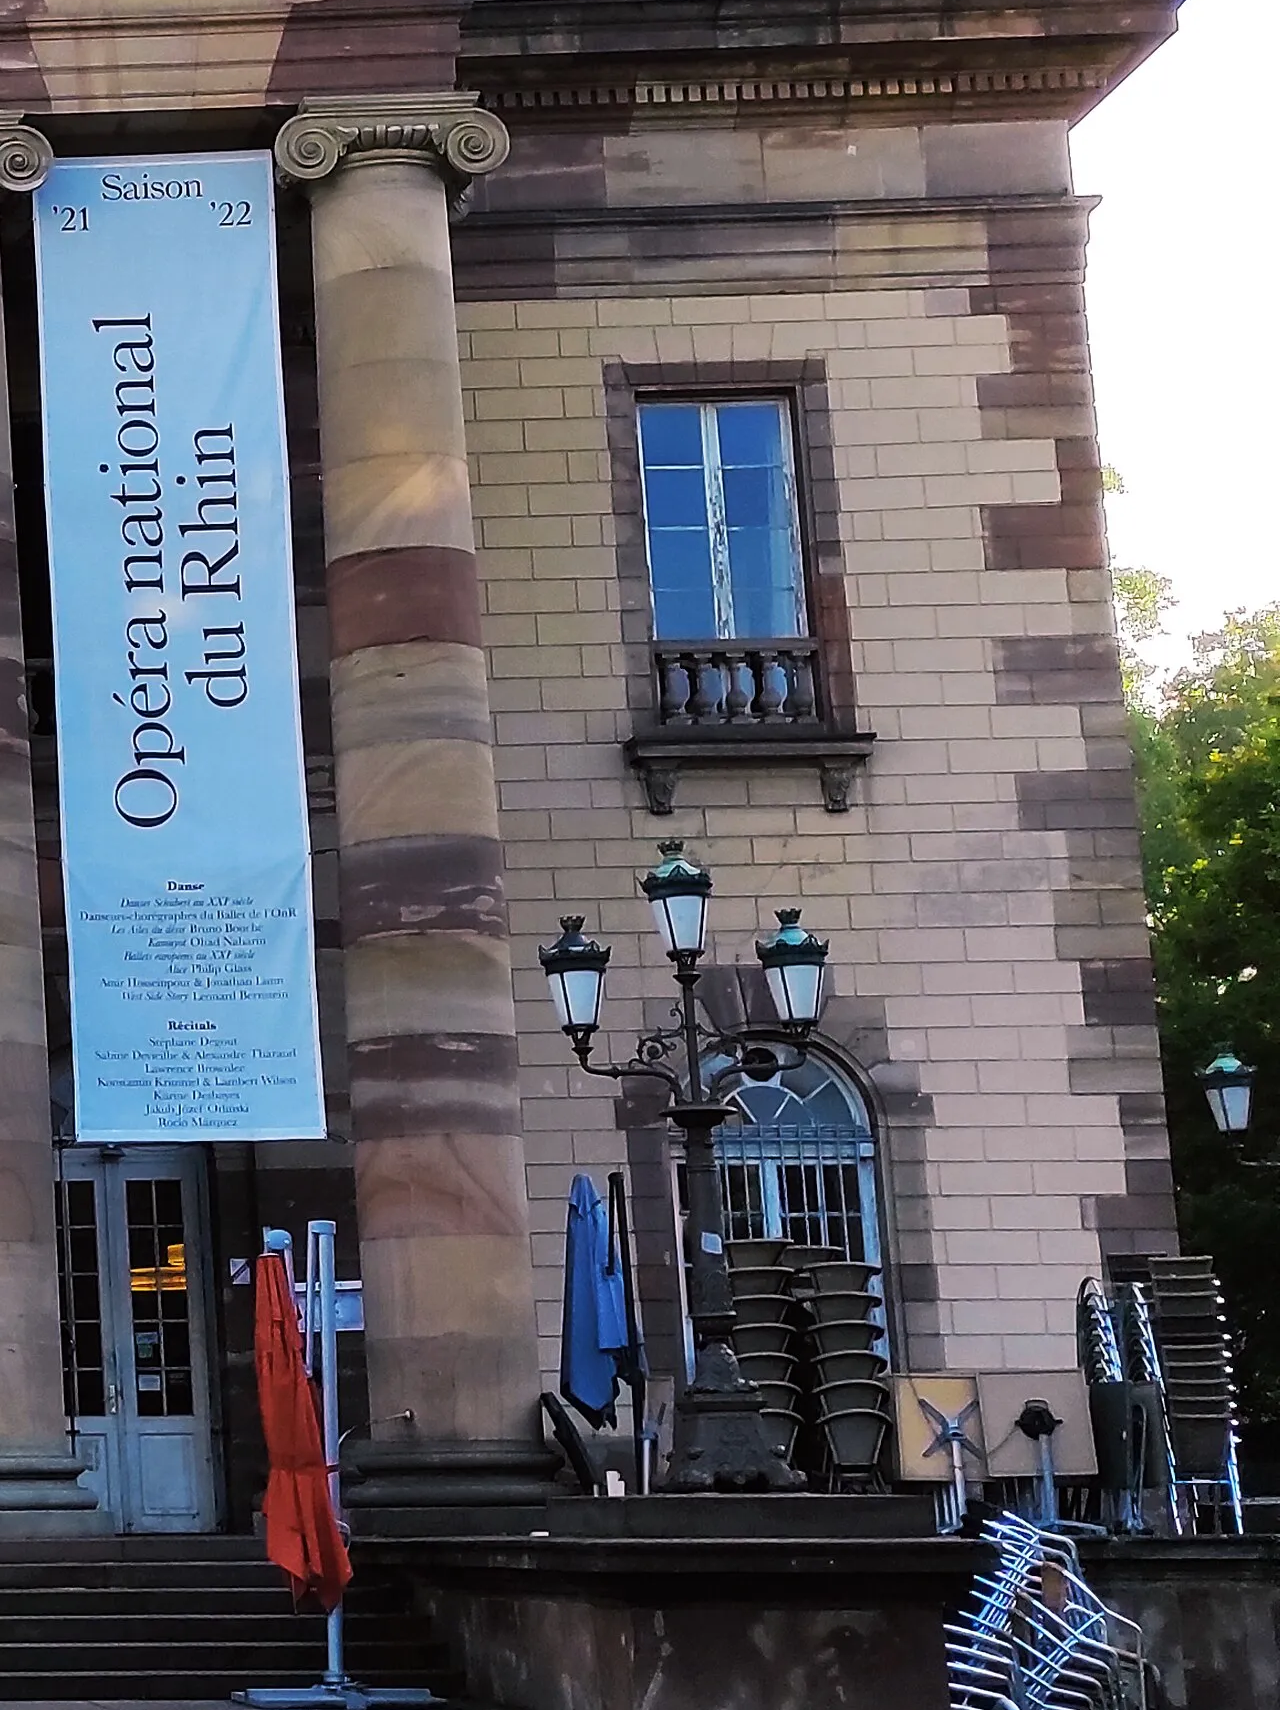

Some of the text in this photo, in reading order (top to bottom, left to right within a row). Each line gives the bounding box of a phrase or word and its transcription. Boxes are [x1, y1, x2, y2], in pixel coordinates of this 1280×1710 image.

[101, 173, 203, 201] Saison
[52, 201, 252, 231] '21 '22
[93, 311, 164, 594] national
[177, 422, 248, 708] du Rhin
[113, 608, 185, 828] Opéra
[167, 881, 204, 891] Danse
[190, 924, 221, 933] Bruno
[191, 964, 221, 975] Philip
[168, 1020, 216, 1030] Récitals
[181, 1051, 190, 1059] &
[202, 1077, 210, 1086] &
